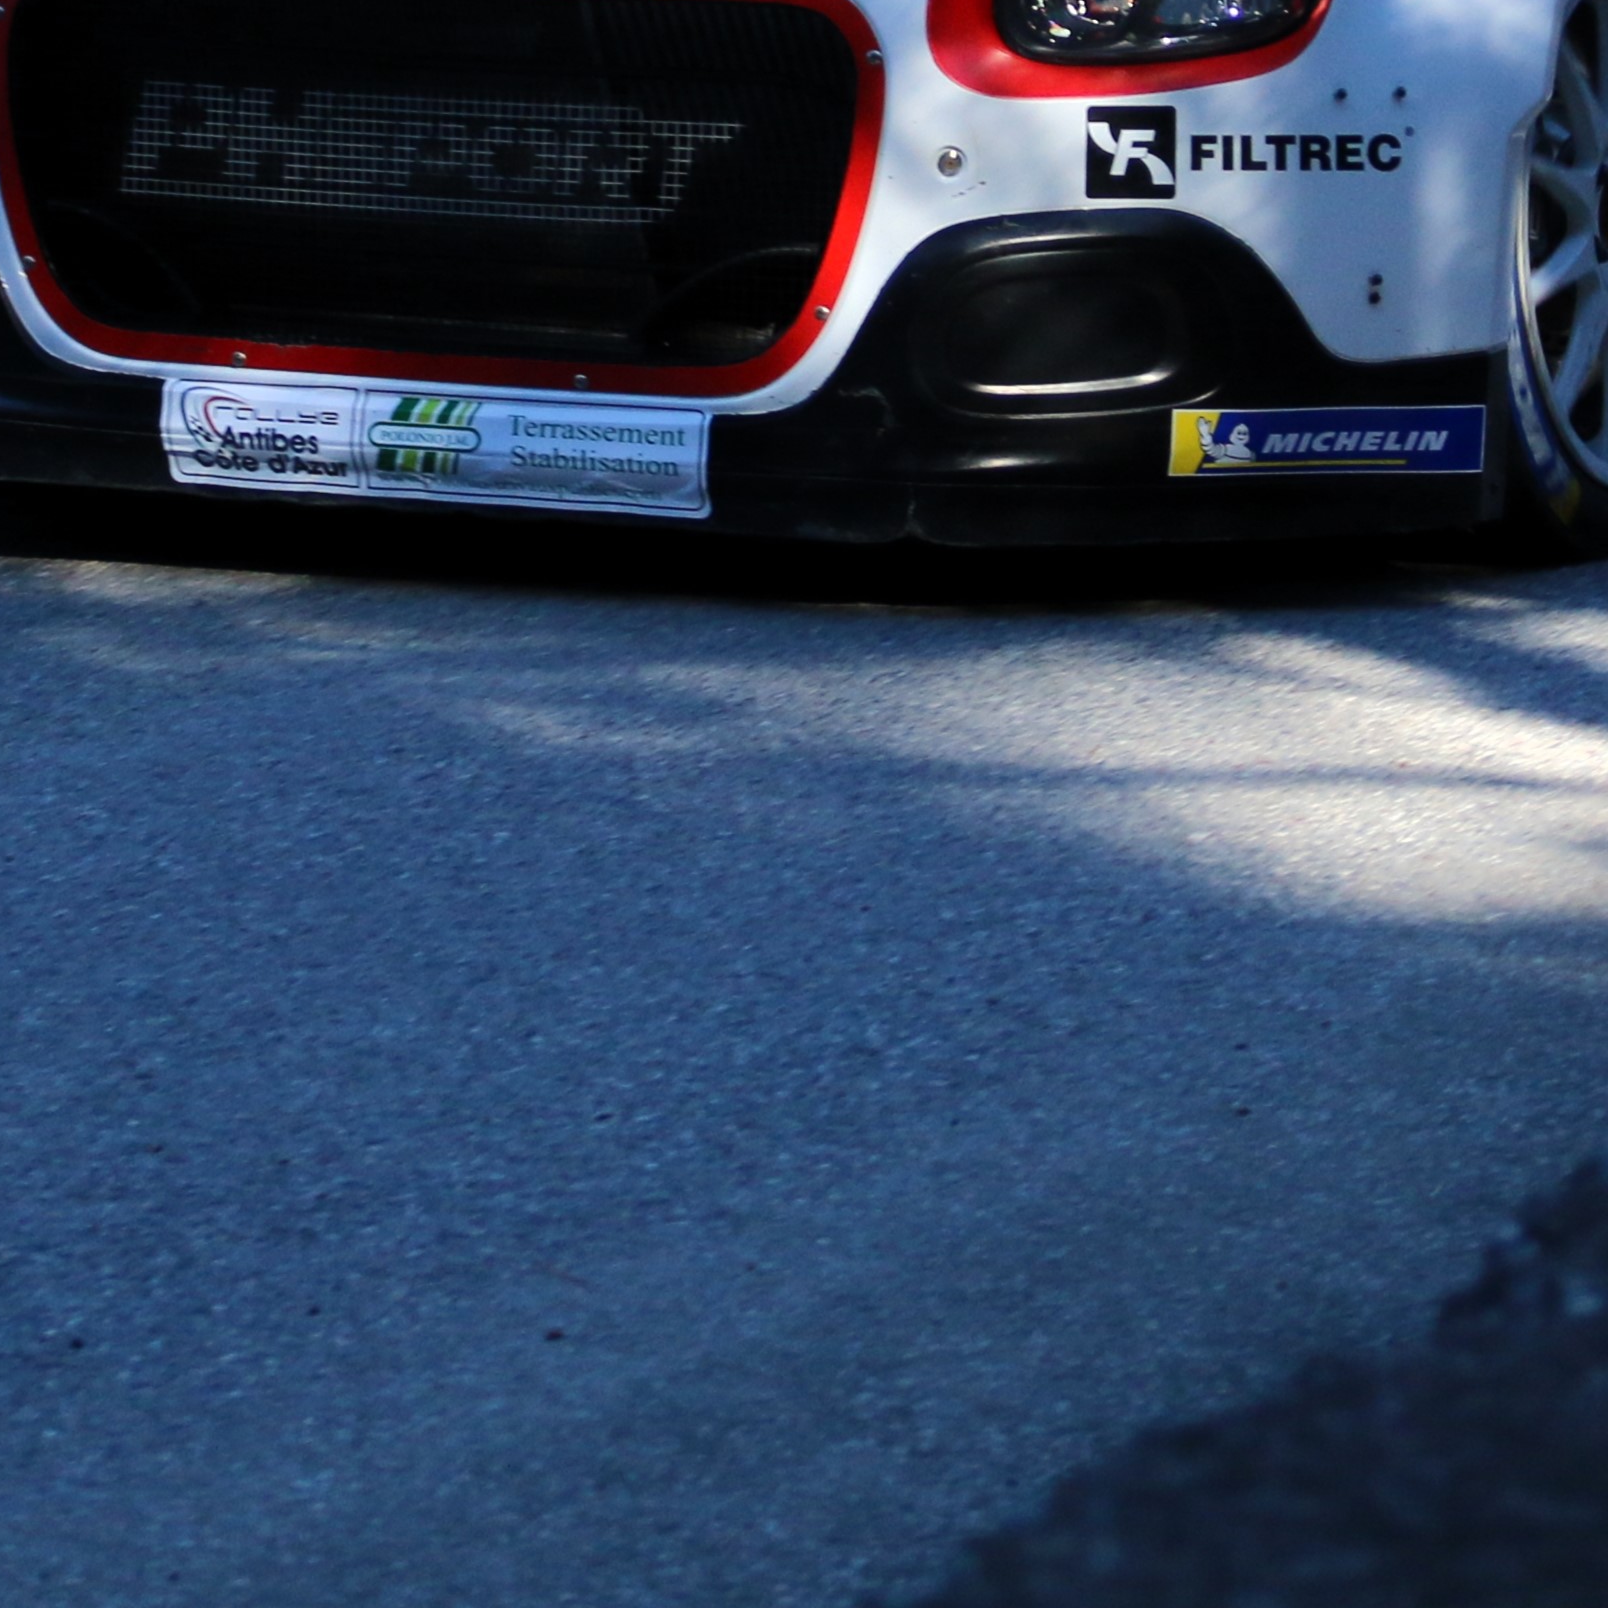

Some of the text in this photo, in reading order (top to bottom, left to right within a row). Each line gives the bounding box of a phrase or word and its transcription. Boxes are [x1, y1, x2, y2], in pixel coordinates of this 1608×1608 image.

[1190, 133, 1402, 172] FILTREC
[219, 426, 320, 455] Antibes
[508, 414, 686, 448] Terrassement
[1261, 430, 1449, 455] MICHELIN
[193, 447, 349, 478] Côte d'Azur
[508, 445, 681, 477] Stabilisation
